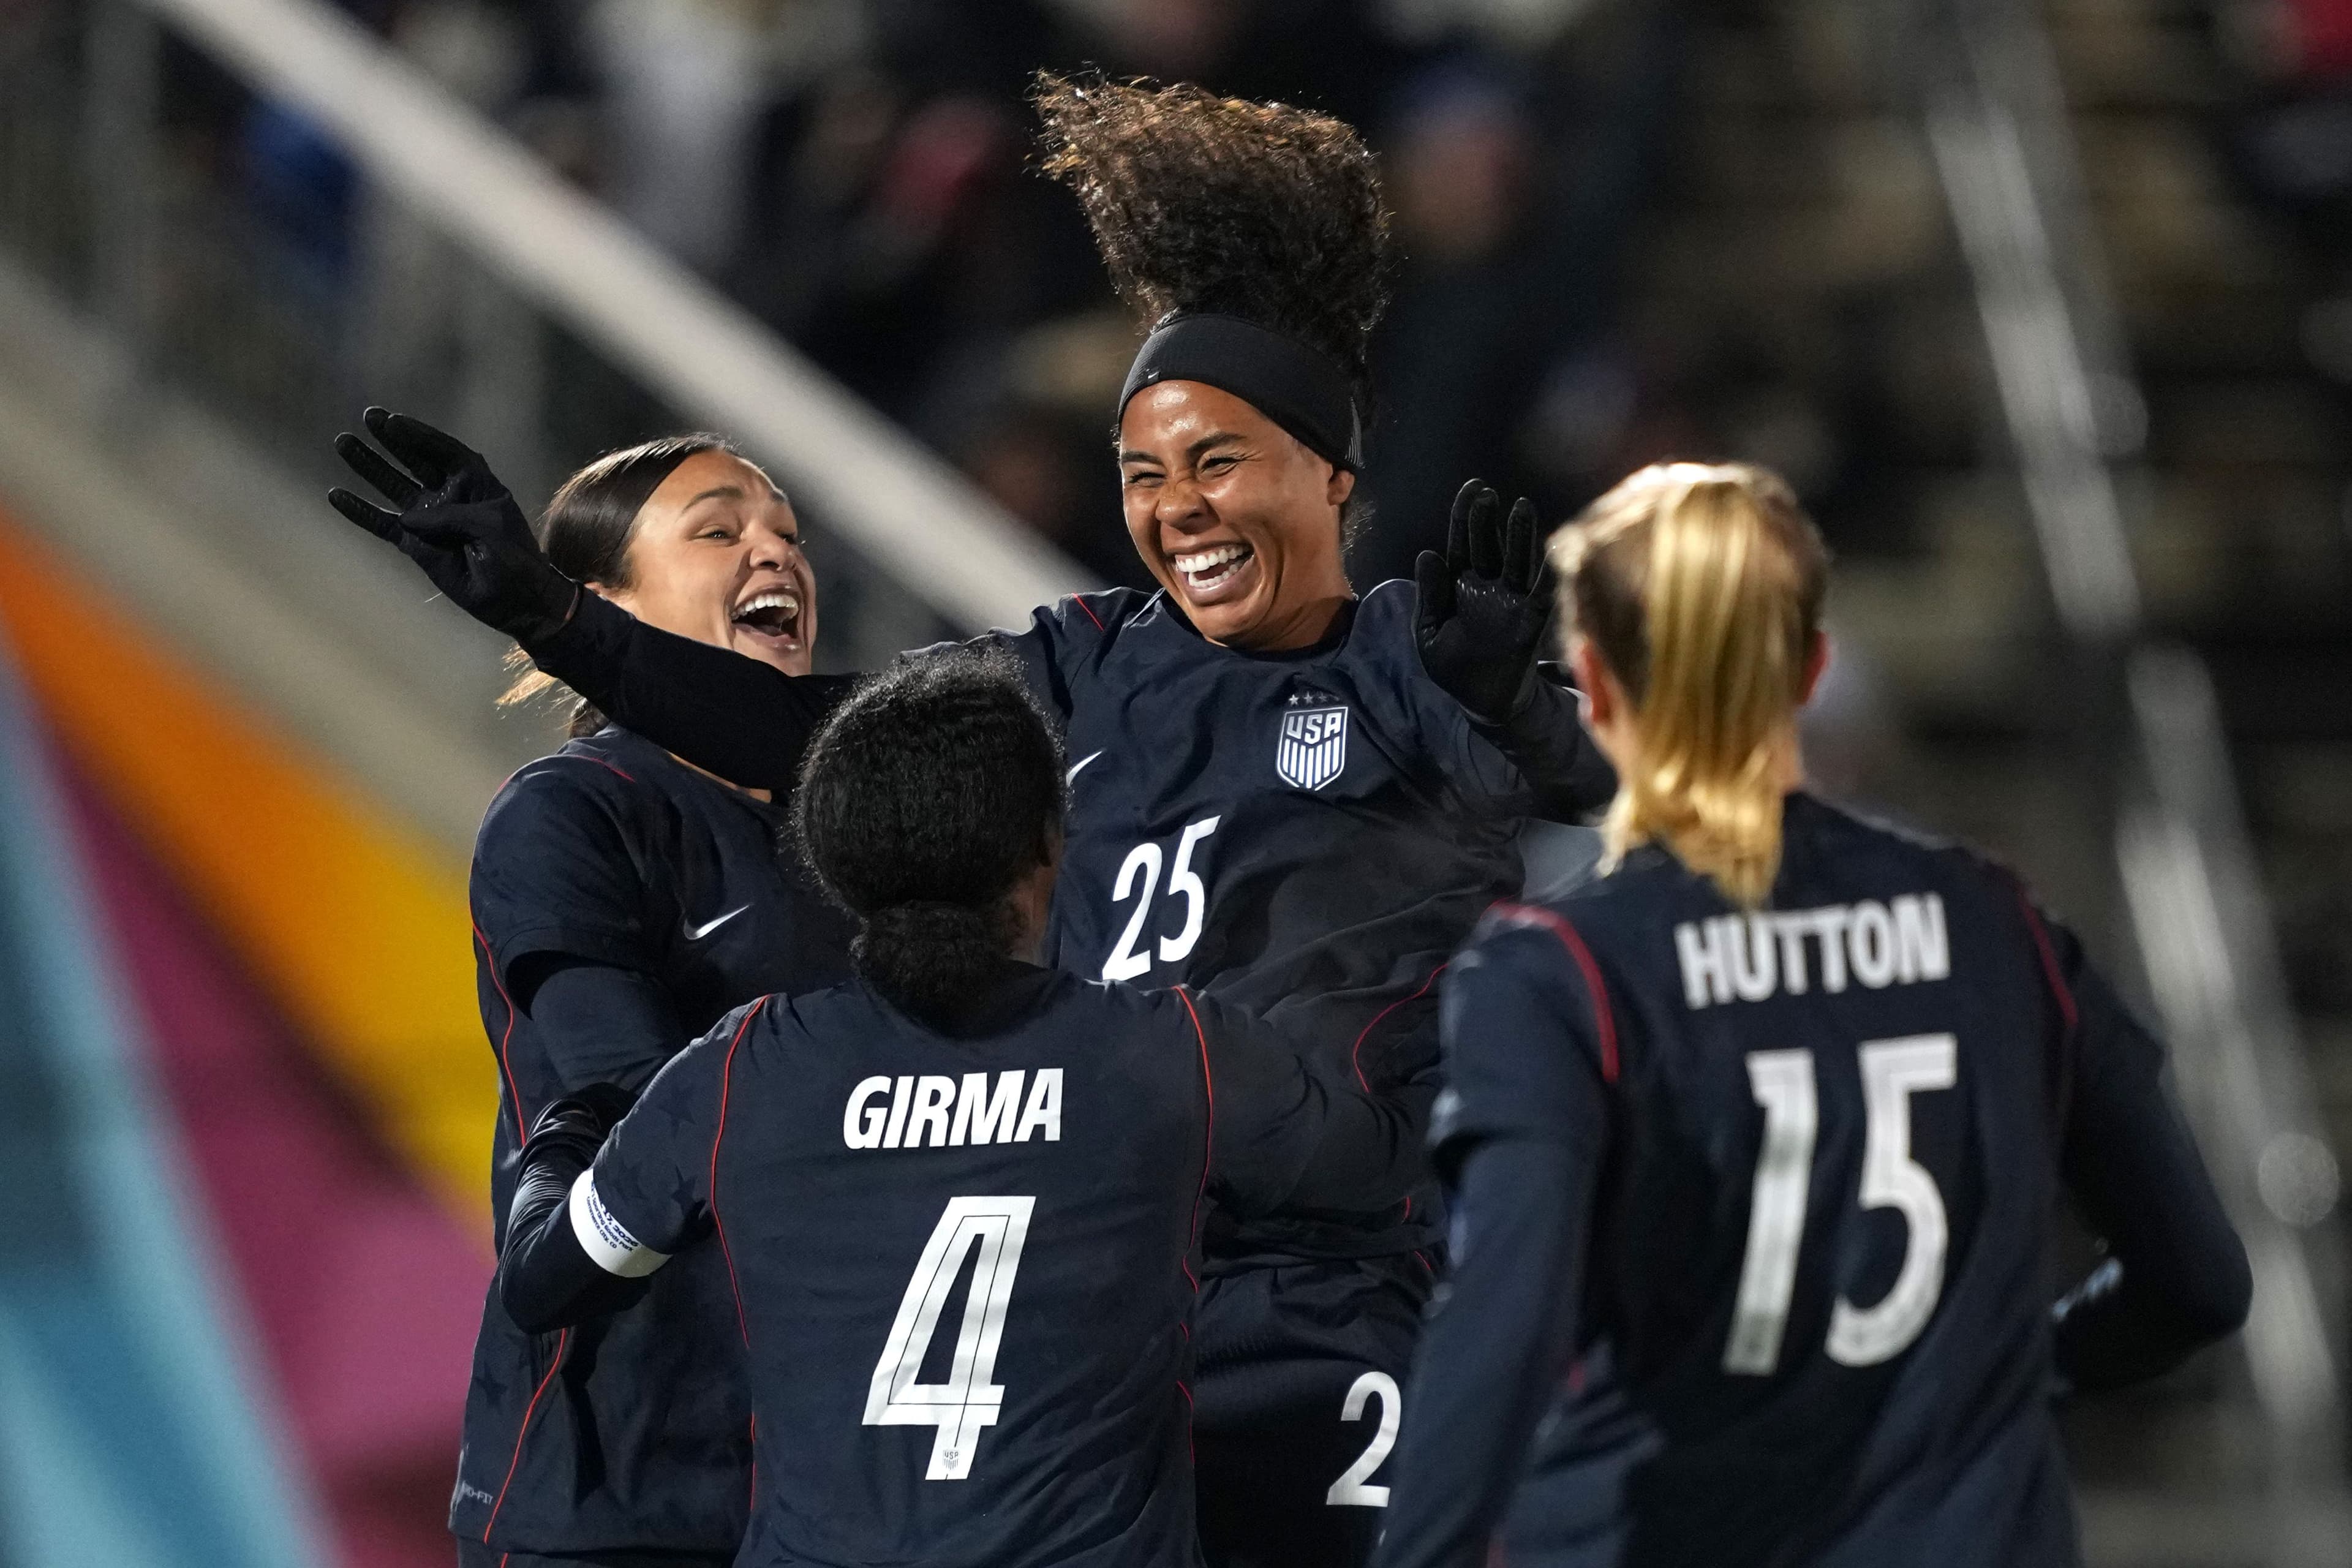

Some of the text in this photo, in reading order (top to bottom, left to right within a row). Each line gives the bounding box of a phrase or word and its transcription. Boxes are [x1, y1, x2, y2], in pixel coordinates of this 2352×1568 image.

[1287, 712, 1342, 744] USA
[1102, 815, 1221, 981] 25
[1674, 892, 1951, 1009] HUTTON
[843, 1068, 1064, 1150] GIRMA
[587, 1196, 600, 1229] Commerce
[592, 1197, 606, 1226] Sporting
[605, 1225, 619, 1242] Goods
[619, 1240, 633, 1251] Park
[612, 1225, 638, 1246] 2026
[1722, 1033, 1958, 1376] 15
[862, 1196, 1036, 1480] 4
[1326, 1371, 1401, 1507] 2
